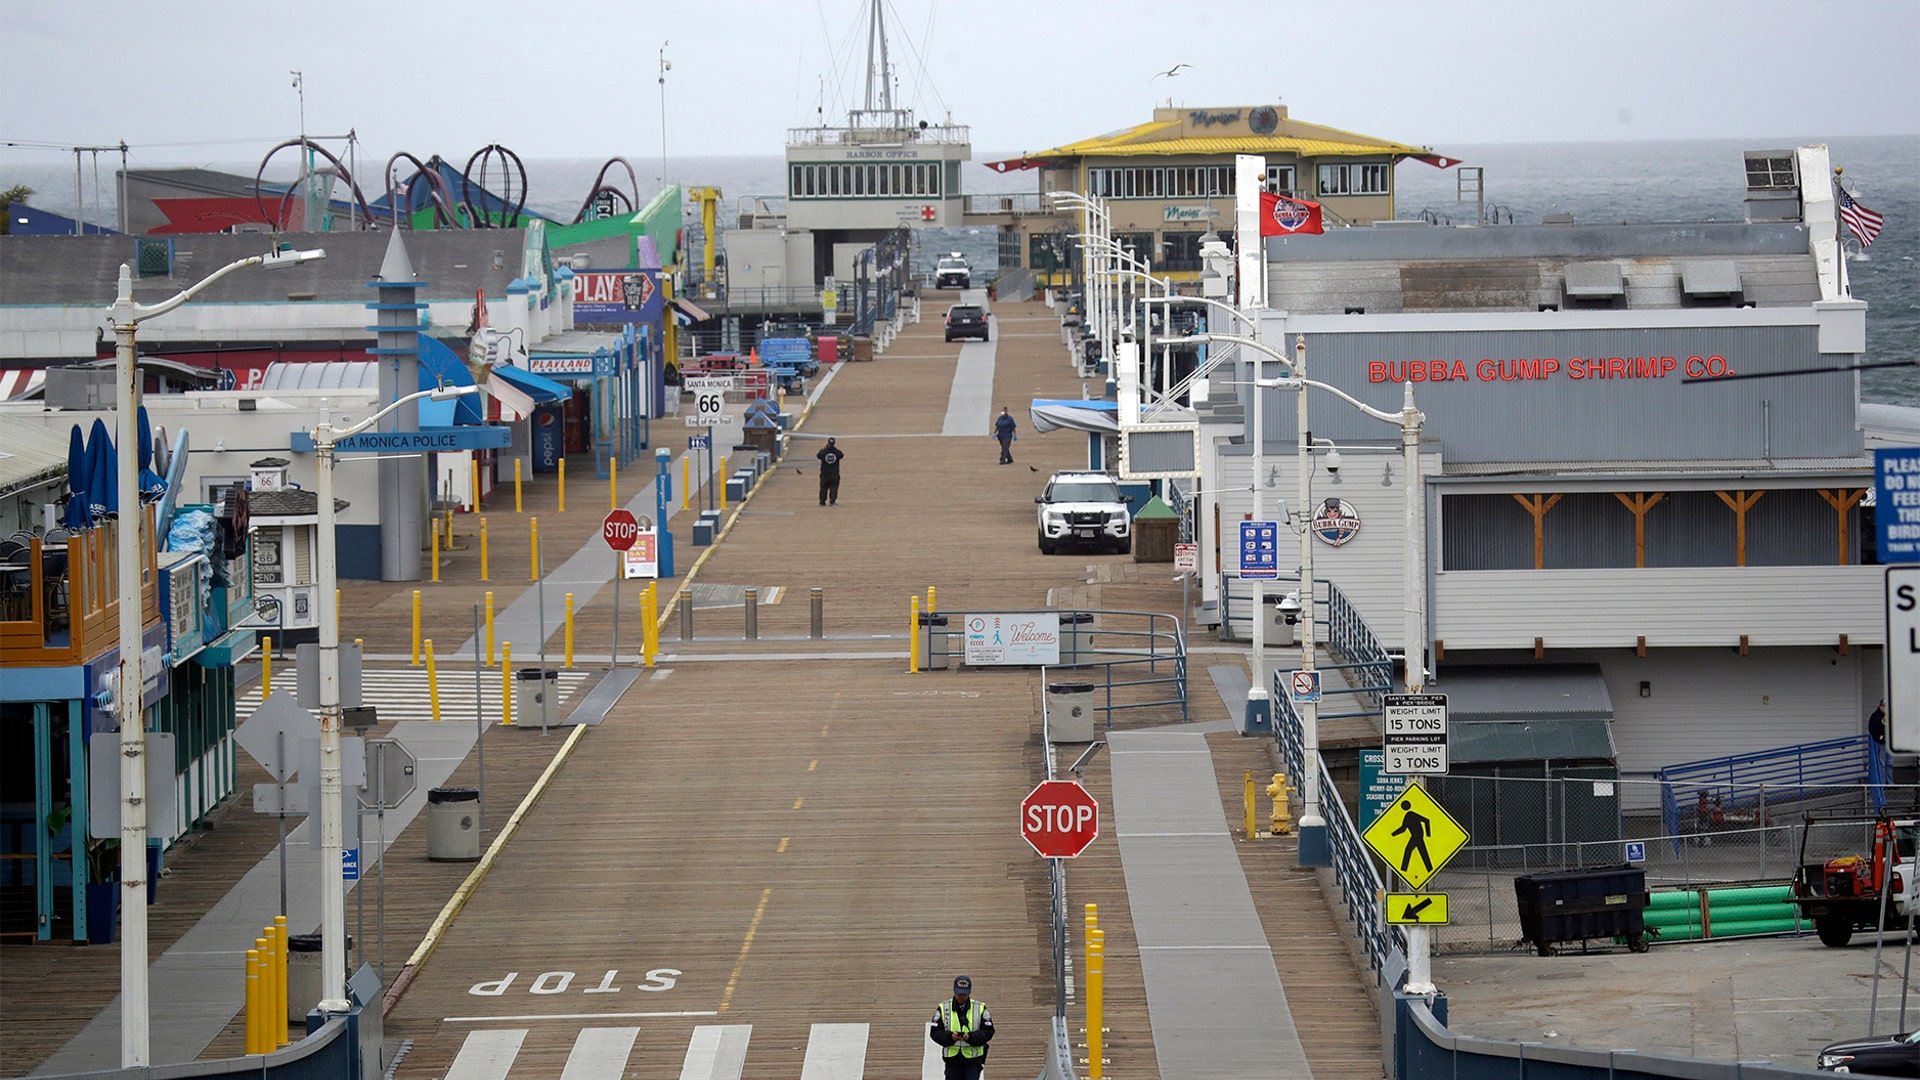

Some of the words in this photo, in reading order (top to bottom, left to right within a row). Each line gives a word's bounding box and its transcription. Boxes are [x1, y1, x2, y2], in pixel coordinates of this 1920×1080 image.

[846, 151, 883, 159] HARBOR
[886, 150, 918, 158] OFFICE
[573, 275, 616, 301] PLAY
[532, 360, 591, 368] PLAYLAND
[1369, 360, 1469, 383] BUBBA
[1476, 359, 1560, 382] GUMP
[1568, 356, 1677, 379] SHRIMP
[1685, 355, 1737, 378] CO.
[699, 395, 720, 413] 66
[360, 437, 409, 448] MONICA
[413, 435, 456, 447] POLICE
[543, 432, 555, 466] pepsi
[261, 477, 272, 486] 66
[1885, 475, 1904, 490] DO
[605, 522, 637, 538] STOP
[1312, 520, 1337, 529] BUBBA
[1339, 519, 1359, 529] GUMP
[259, 554, 273, 563] 66
[258, 573, 275, 583] END
[1010, 621, 1056, 646] Welcome
[1390, 719, 1403, 730] 15
[1408, 719, 1441, 730] TONS
[1393, 758, 1402, 769] 3
[1406, 758, 1440, 769] TONS
[1026, 805, 1093, 833] STOP
[468, 968, 682, 996] STOP
